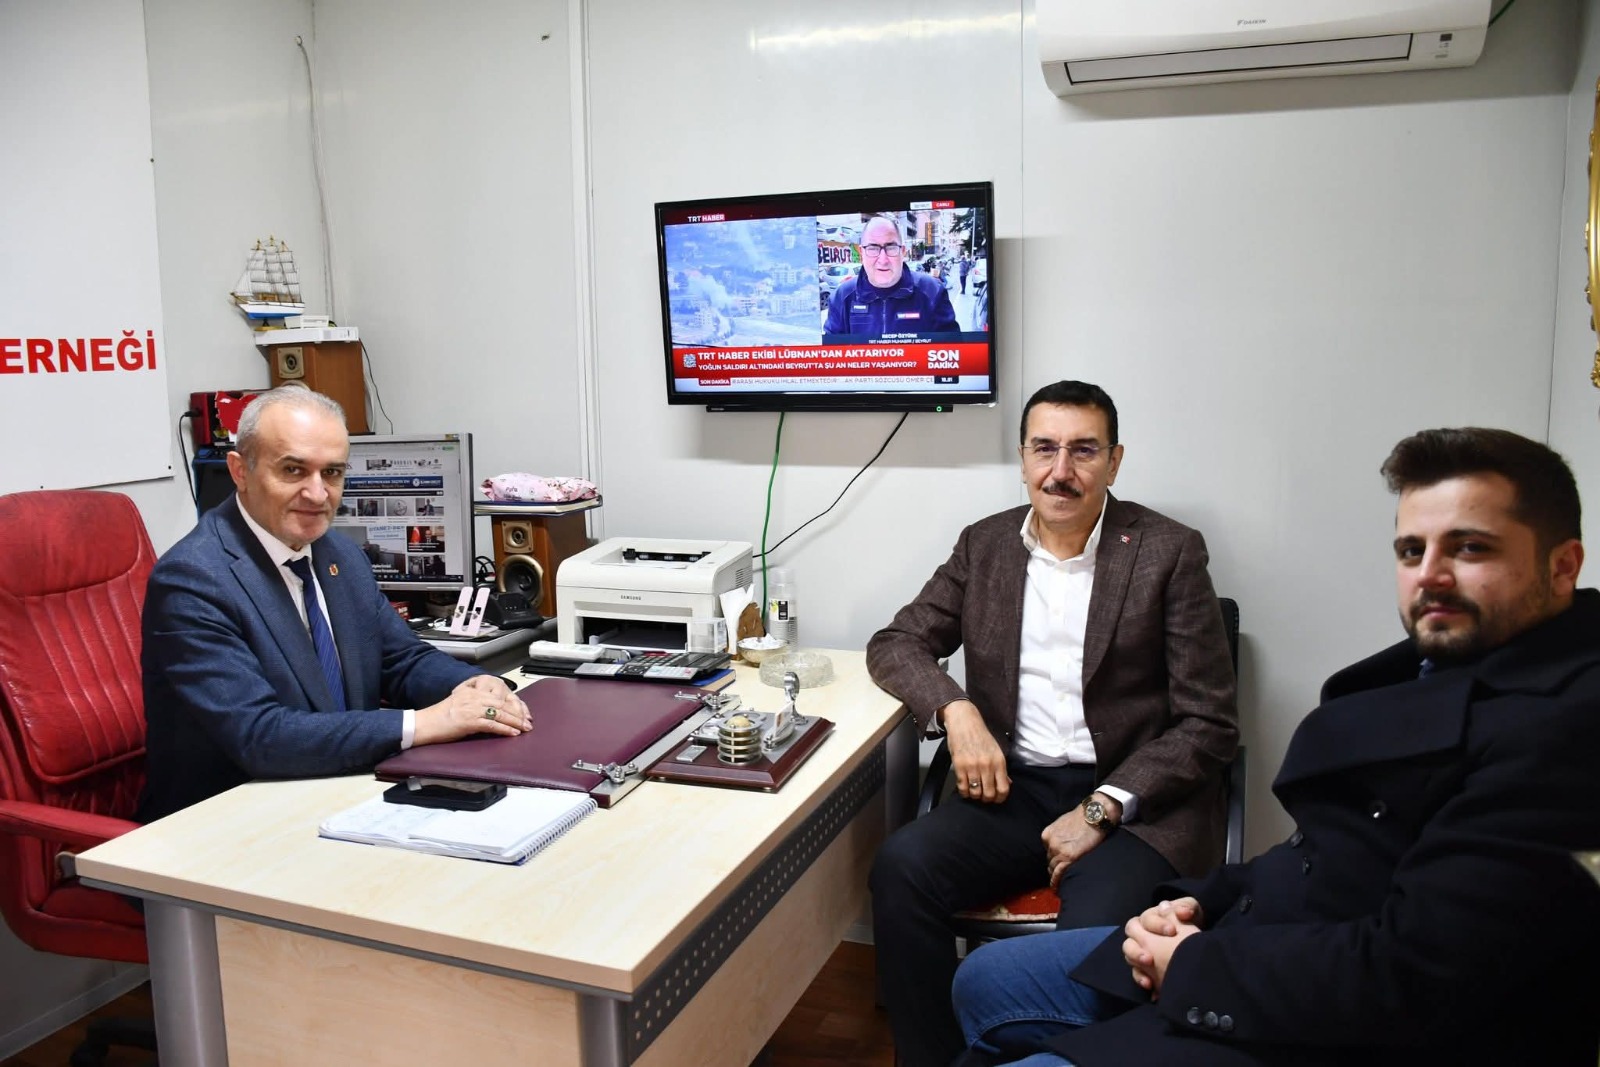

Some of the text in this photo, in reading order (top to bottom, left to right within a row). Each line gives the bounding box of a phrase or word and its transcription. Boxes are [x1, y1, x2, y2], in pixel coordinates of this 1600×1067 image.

[0, 330, 156, 374] ERNEĞİ
[698, 348, 904, 360] TRT HABER EKİBİ LÜBNAN'DAN AKTARIYOR
[927, 350, 960, 361] SON
[698, 363, 722, 371] YOĞUN
[749, 362, 785, 370] ALTINDAKİ
[927, 360, 960, 369] DAKİKA
